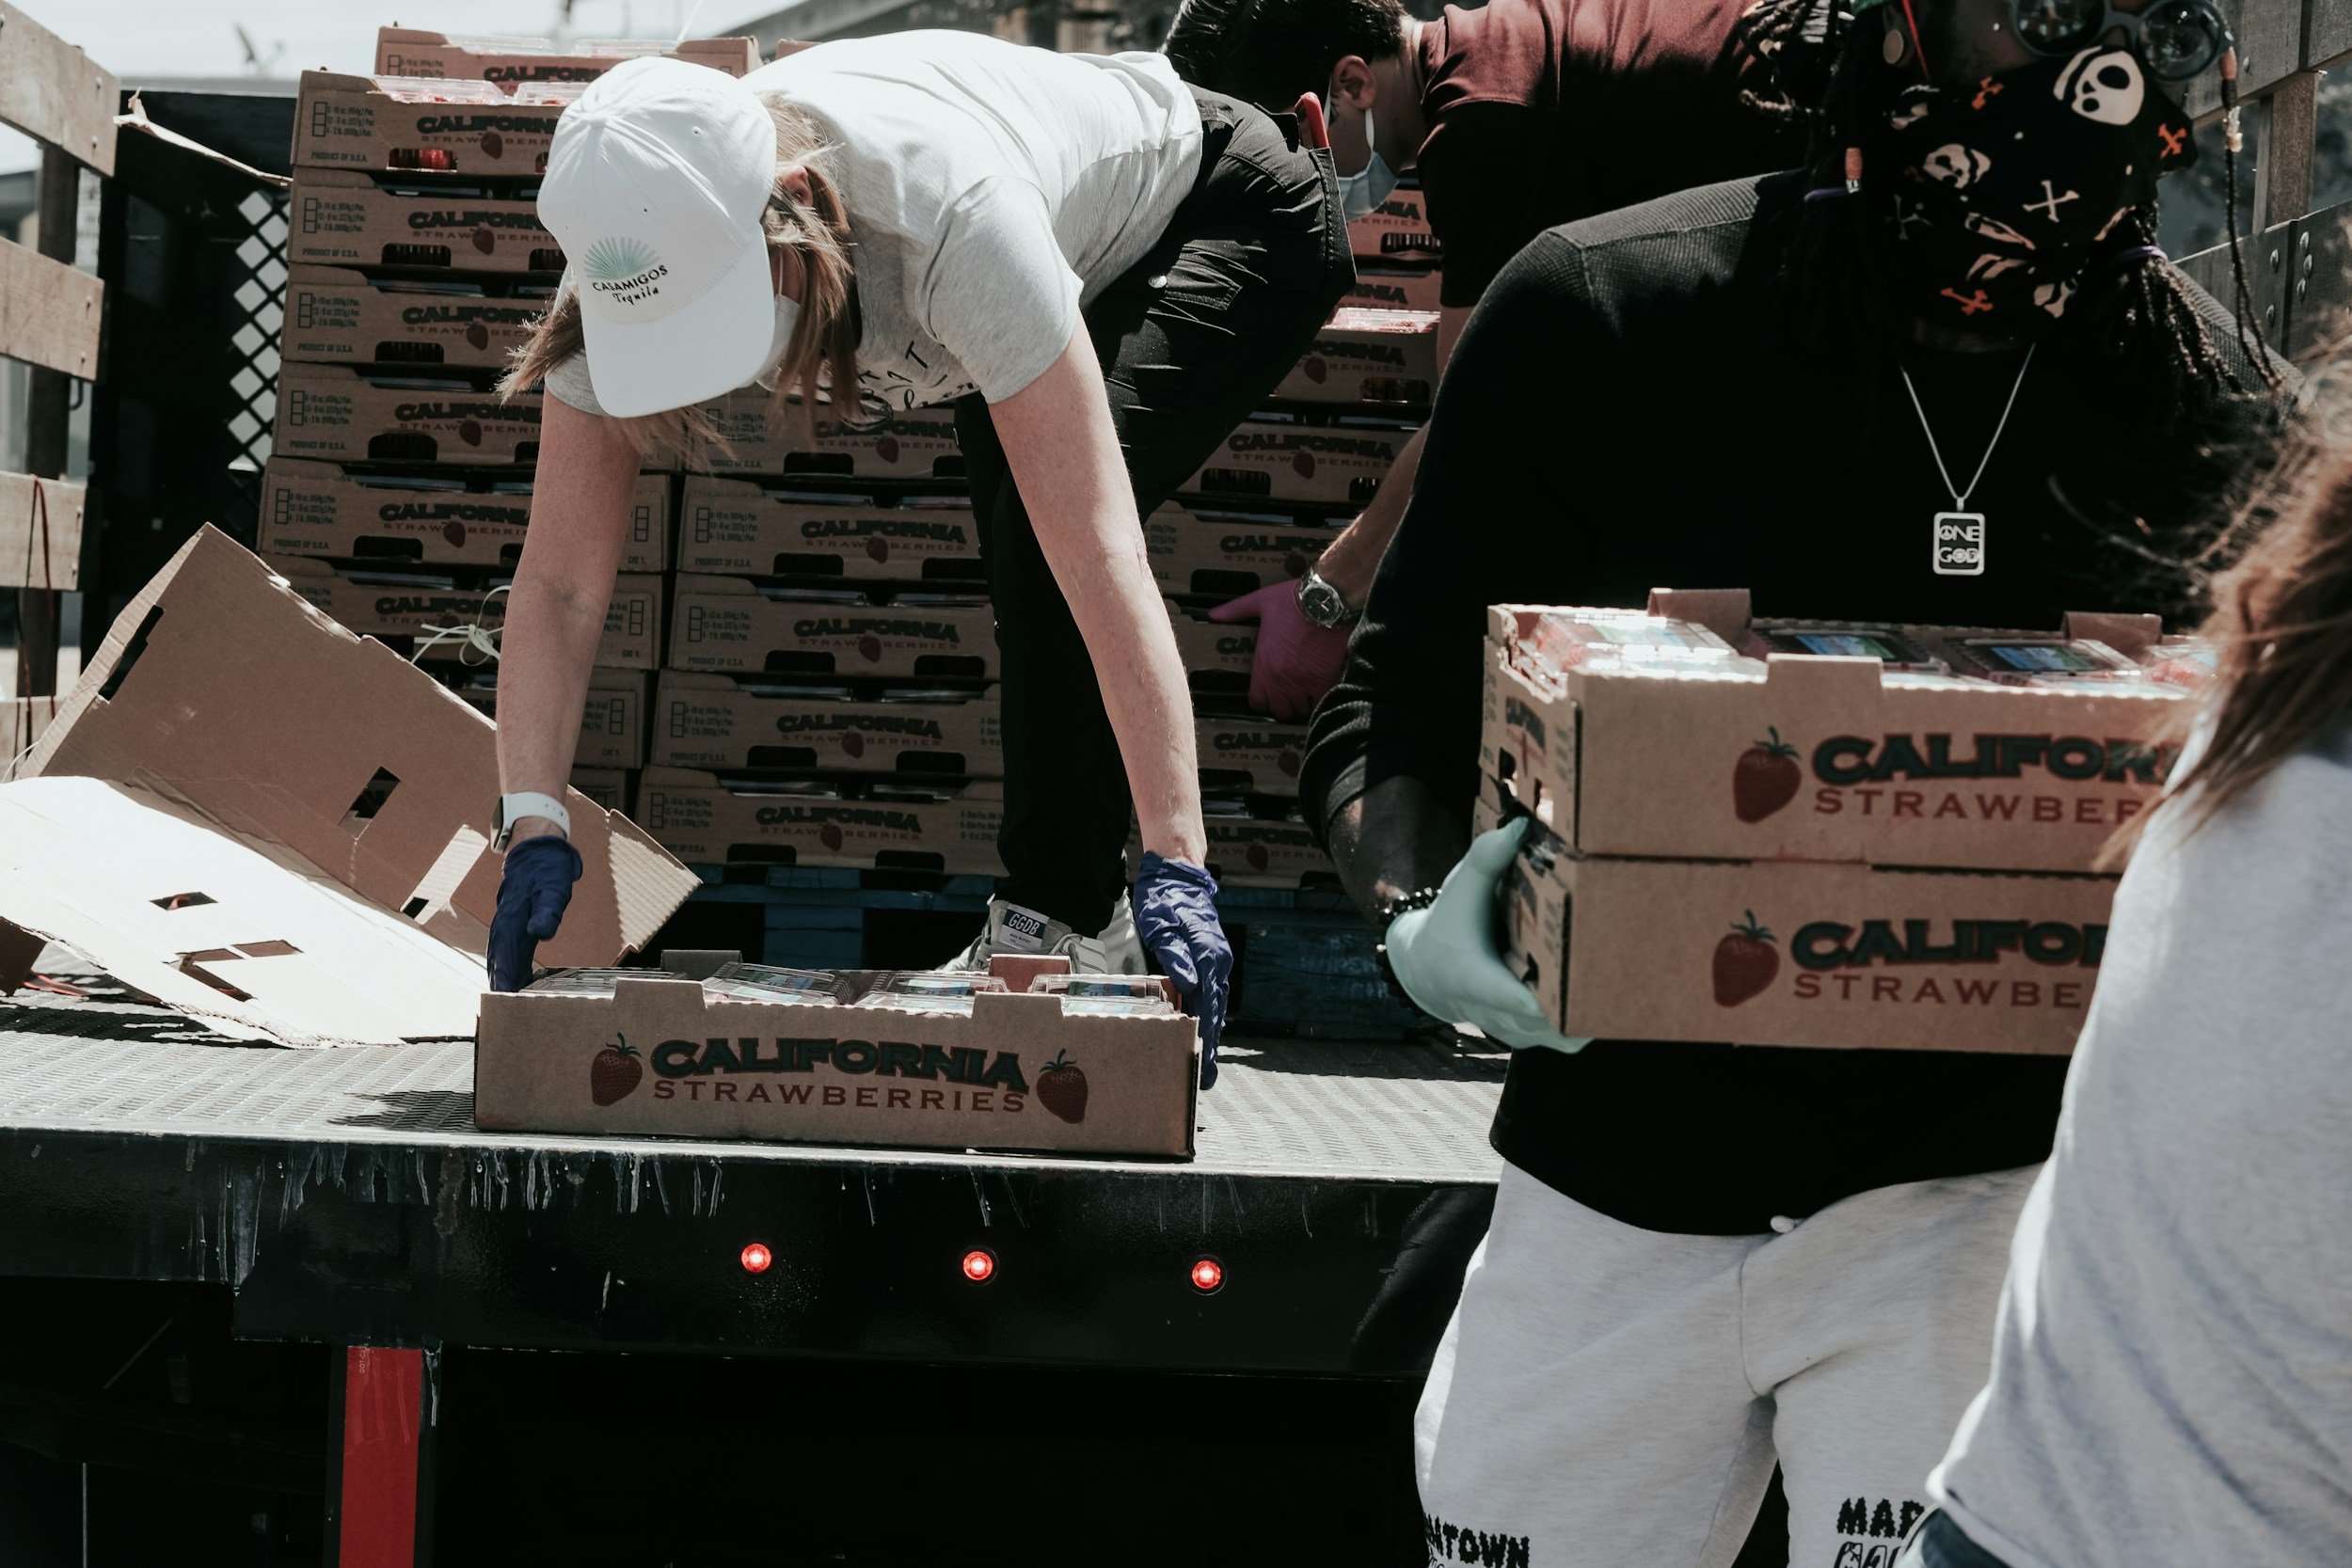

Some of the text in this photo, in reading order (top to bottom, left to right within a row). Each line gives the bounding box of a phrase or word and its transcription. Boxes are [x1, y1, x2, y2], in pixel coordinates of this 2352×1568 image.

[592, 264, 668, 292] CASAMIGOS
[612, 286, 660, 306] Tequila
[1228, 432, 1395, 461] CALIFORNIA
[801, 519, 966, 545] CALIFORNIA
[1939, 525, 1980, 542] ONE
[793, 618, 961, 643] CALIFORNIA
[776, 714, 943, 739] CALIFORNIA
[755, 806, 923, 834] CALIFORNIA
[1009, 913, 1041, 936] GGDB
[1794, 972, 2083, 1010] STRAWBE
[650, 1036, 1030, 1097] CALIFORNIA
[653, 1077, 1025, 1114] STRAWBERRIES
